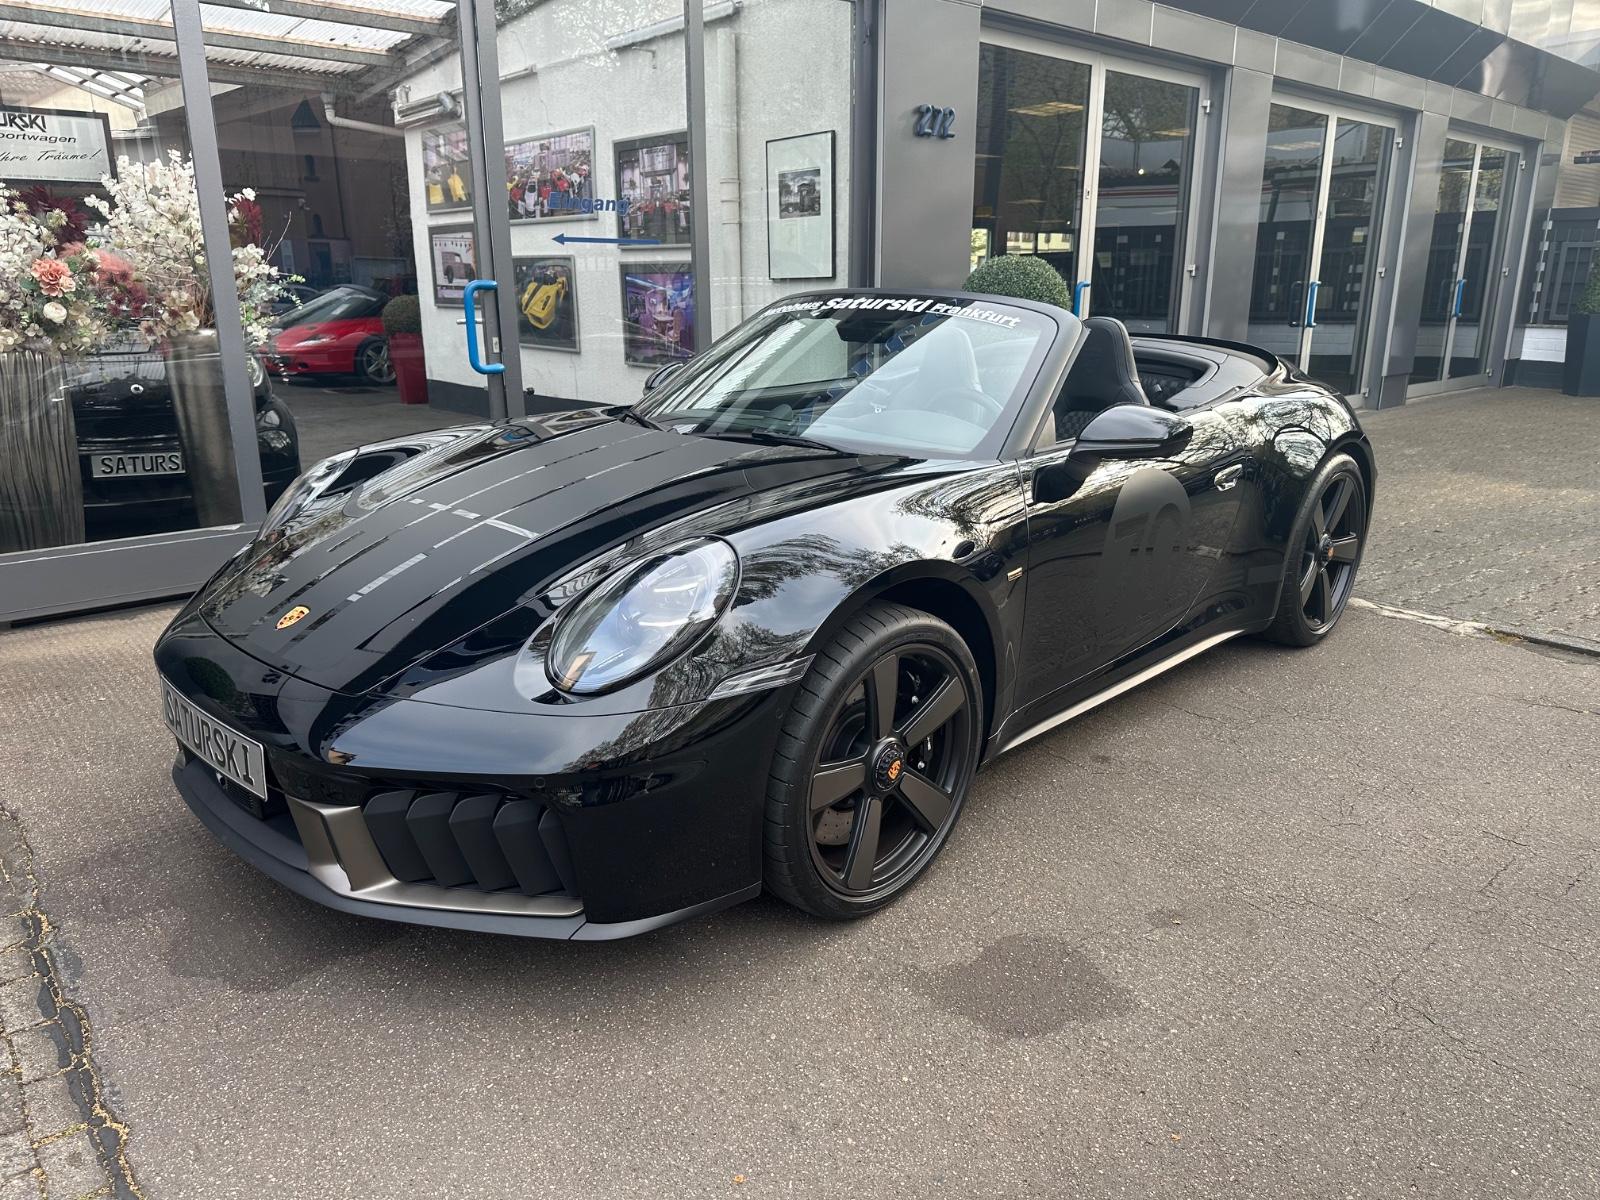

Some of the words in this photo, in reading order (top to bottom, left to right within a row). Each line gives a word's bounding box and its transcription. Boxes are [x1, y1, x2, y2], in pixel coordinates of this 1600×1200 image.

[37, 149, 101, 162] Träume!
[548, 192, 630, 216] Eingang
[930, 303, 1021, 328] Frankfurt
[167, 689, 254, 786] SATURSKI
